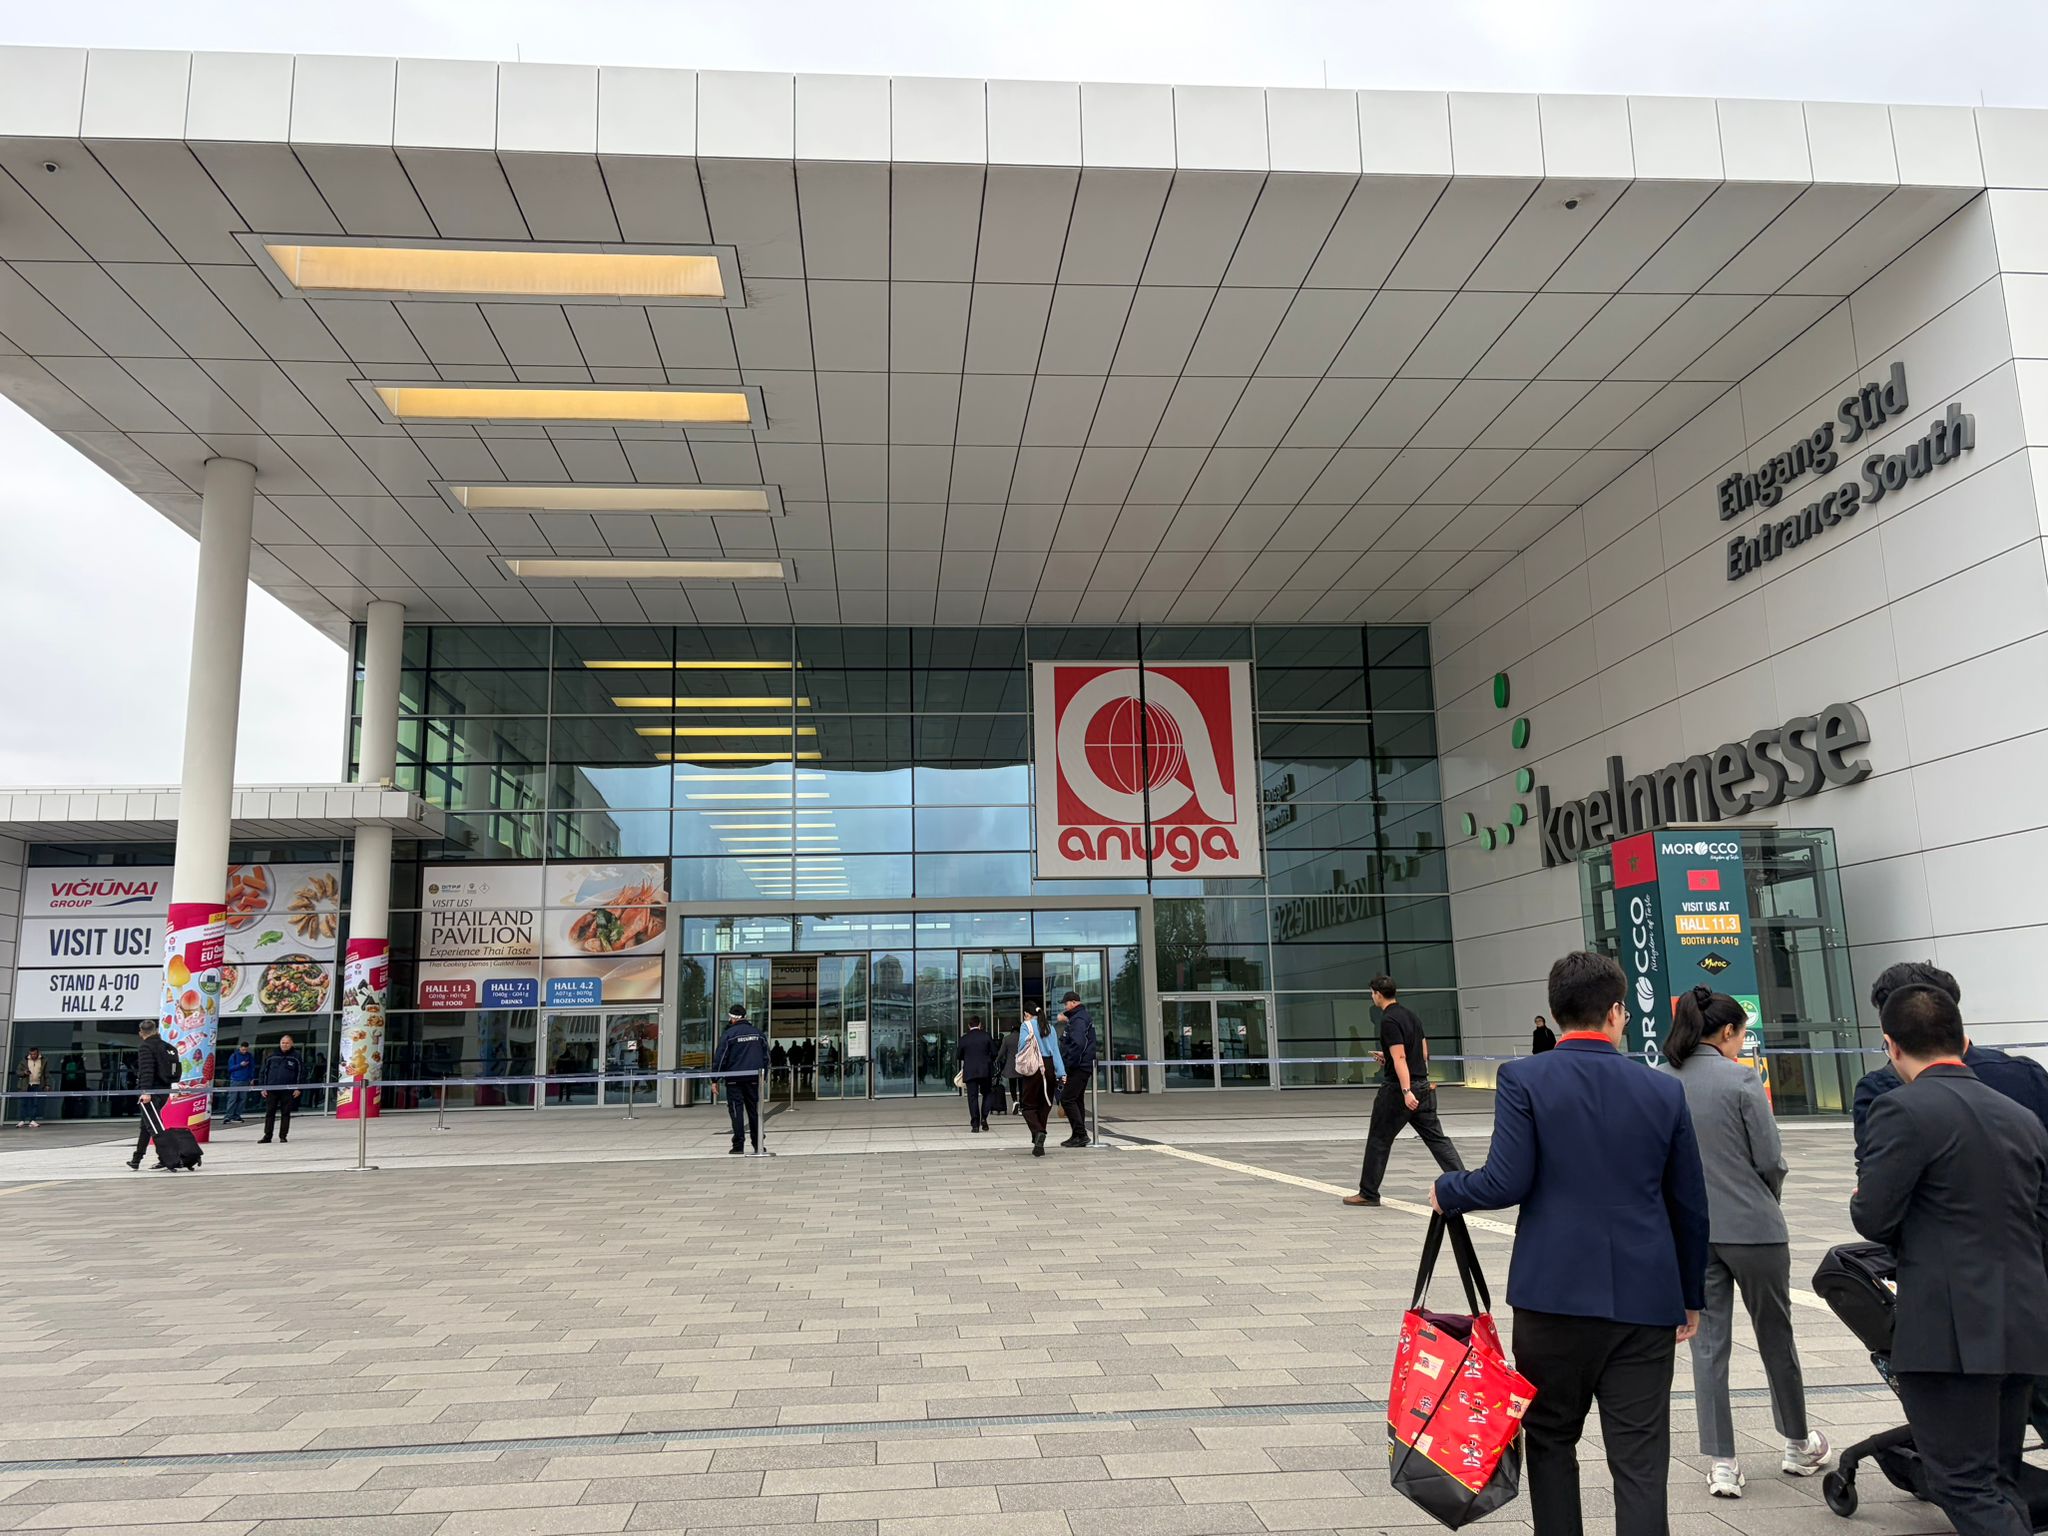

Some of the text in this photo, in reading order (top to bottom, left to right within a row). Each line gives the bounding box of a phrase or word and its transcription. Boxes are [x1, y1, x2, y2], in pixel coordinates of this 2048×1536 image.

[1716, 362, 1909, 521] Eingang Süd
[1727, 402, 1976, 581] Entrance South
[1535, 702, 1873, 867] koelnmesse
[1058, 826, 1239, 872] anuga
[51, 878, 158, 896] VIČIŪNAI
[50, 899, 92, 908] GROUP
[432, 899, 473, 908] VISIT US!
[1682, 902, 1730, 912] VISIT US AT
[431, 910, 533, 926] THAILAND
[1680, 917, 1737, 931] HALL 11.3
[50, 928, 108, 956] VISIT
[113, 927, 152, 956] US!
[431, 927, 532, 944] PAVILION
[1681, 937, 1706, 946] BOOTH
[1713, 936, 1739, 946] A-041g
[430, 946, 532, 958] Experience Thai Taste
[50, 973, 140, 992] STAND A-010
[425, 984, 471, 993] HALL 11.3
[491, 983, 515, 991] HALL
[554, 982, 594, 991] HALL 4.2
[1630, 896, 1659, 1069] OROCCO
[61, 995, 124, 1013] HALL 4.2
